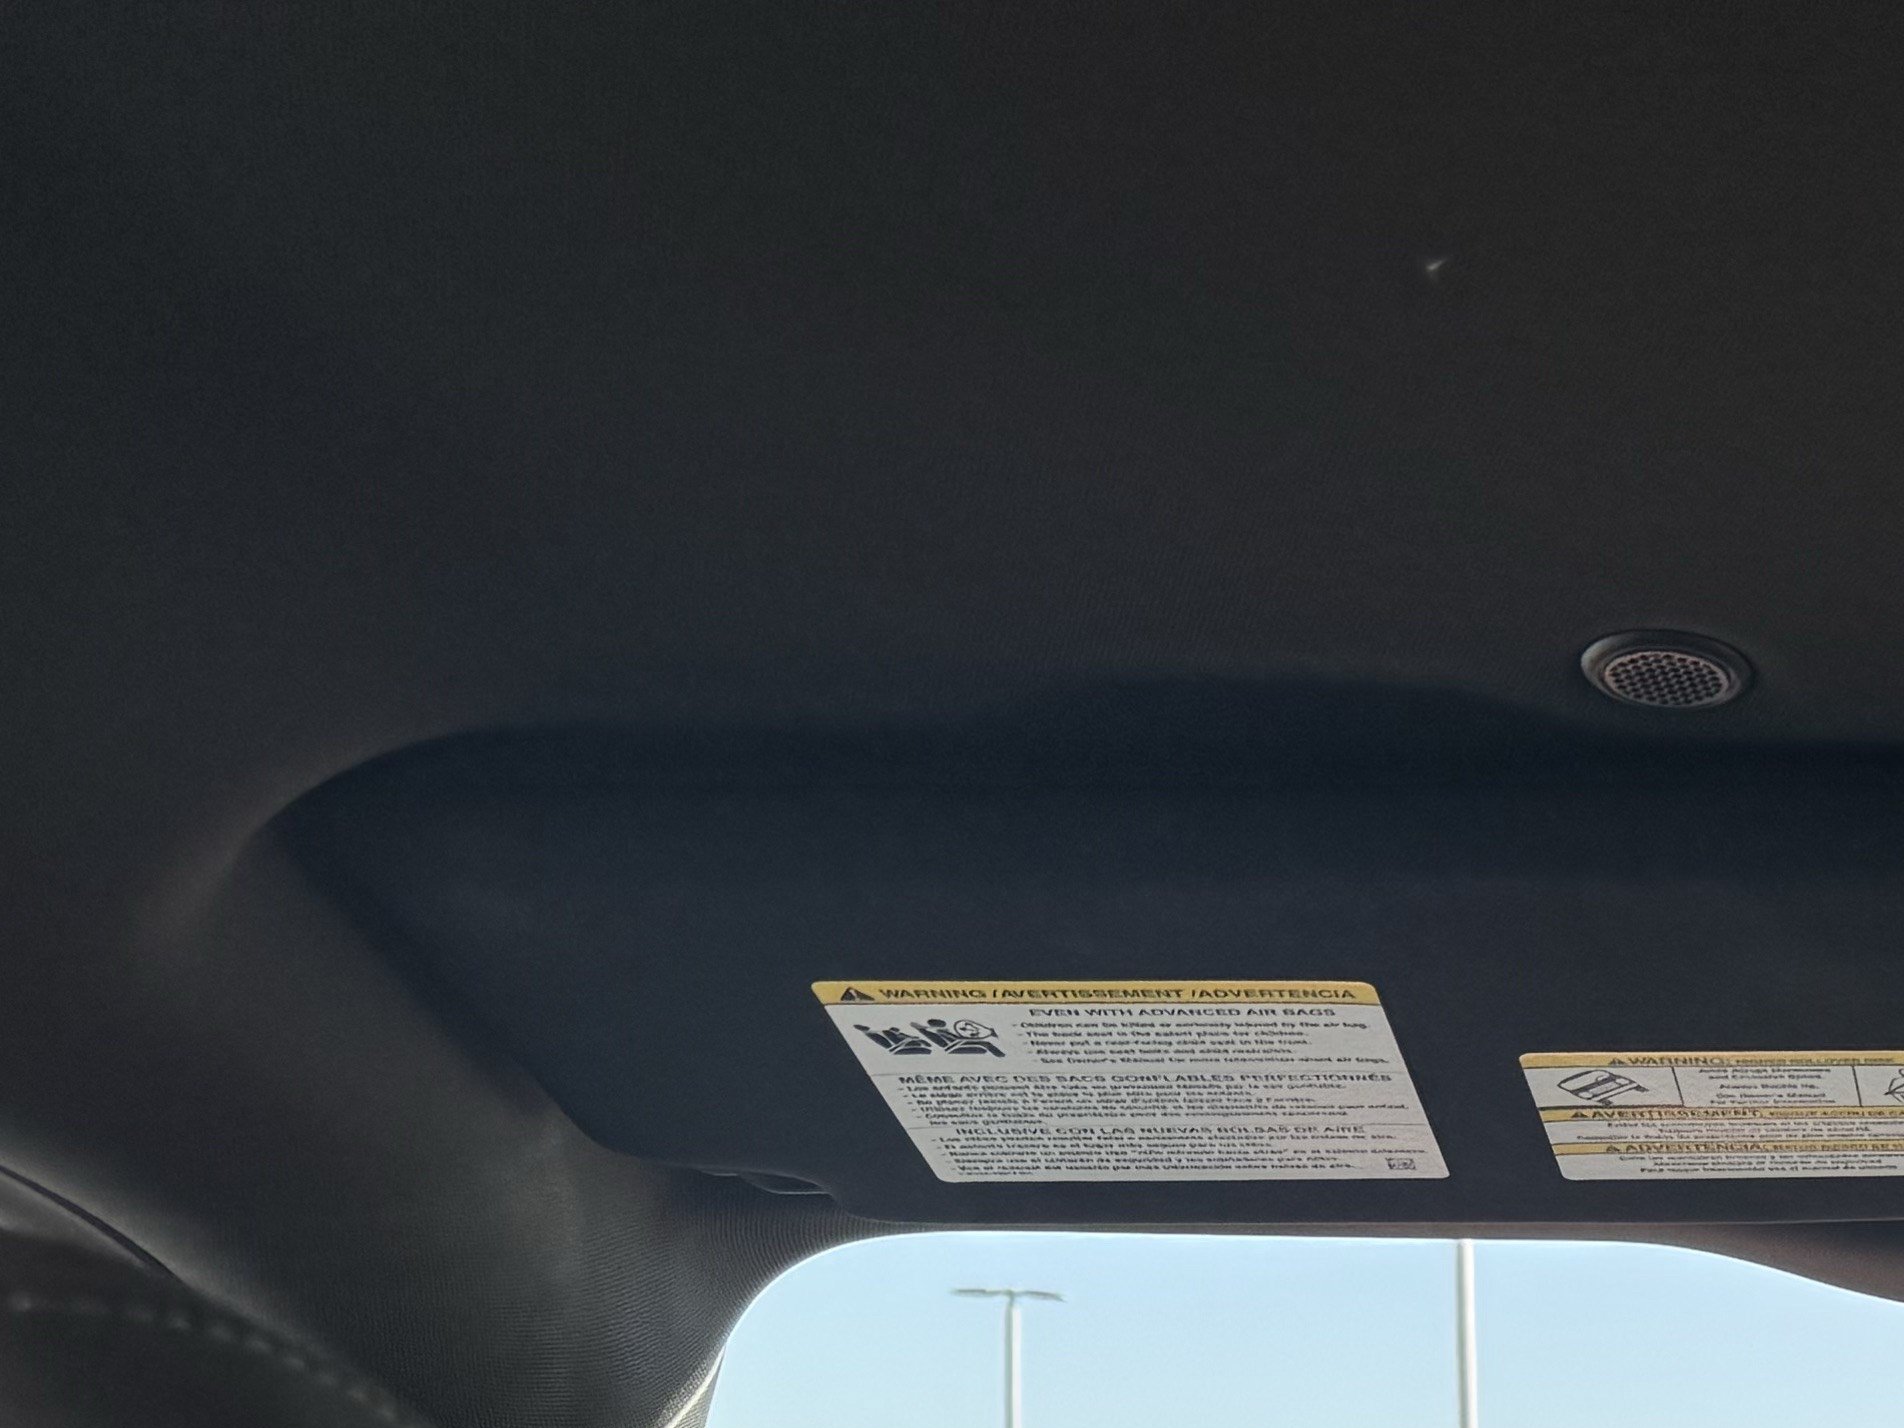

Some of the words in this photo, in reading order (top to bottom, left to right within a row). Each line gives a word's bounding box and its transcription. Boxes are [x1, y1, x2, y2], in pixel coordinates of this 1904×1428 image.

[879, 988, 987, 999] WARNING
[1029, 1008, 1080, 1017] EVEN
[1085, 1008, 1132, 1017] WITH
[1138, 1008, 1240, 1017] ADVANCED
[1247, 1008, 1276, 1017] AIR
[1283, 1008, 1336, 1017] BAGS
